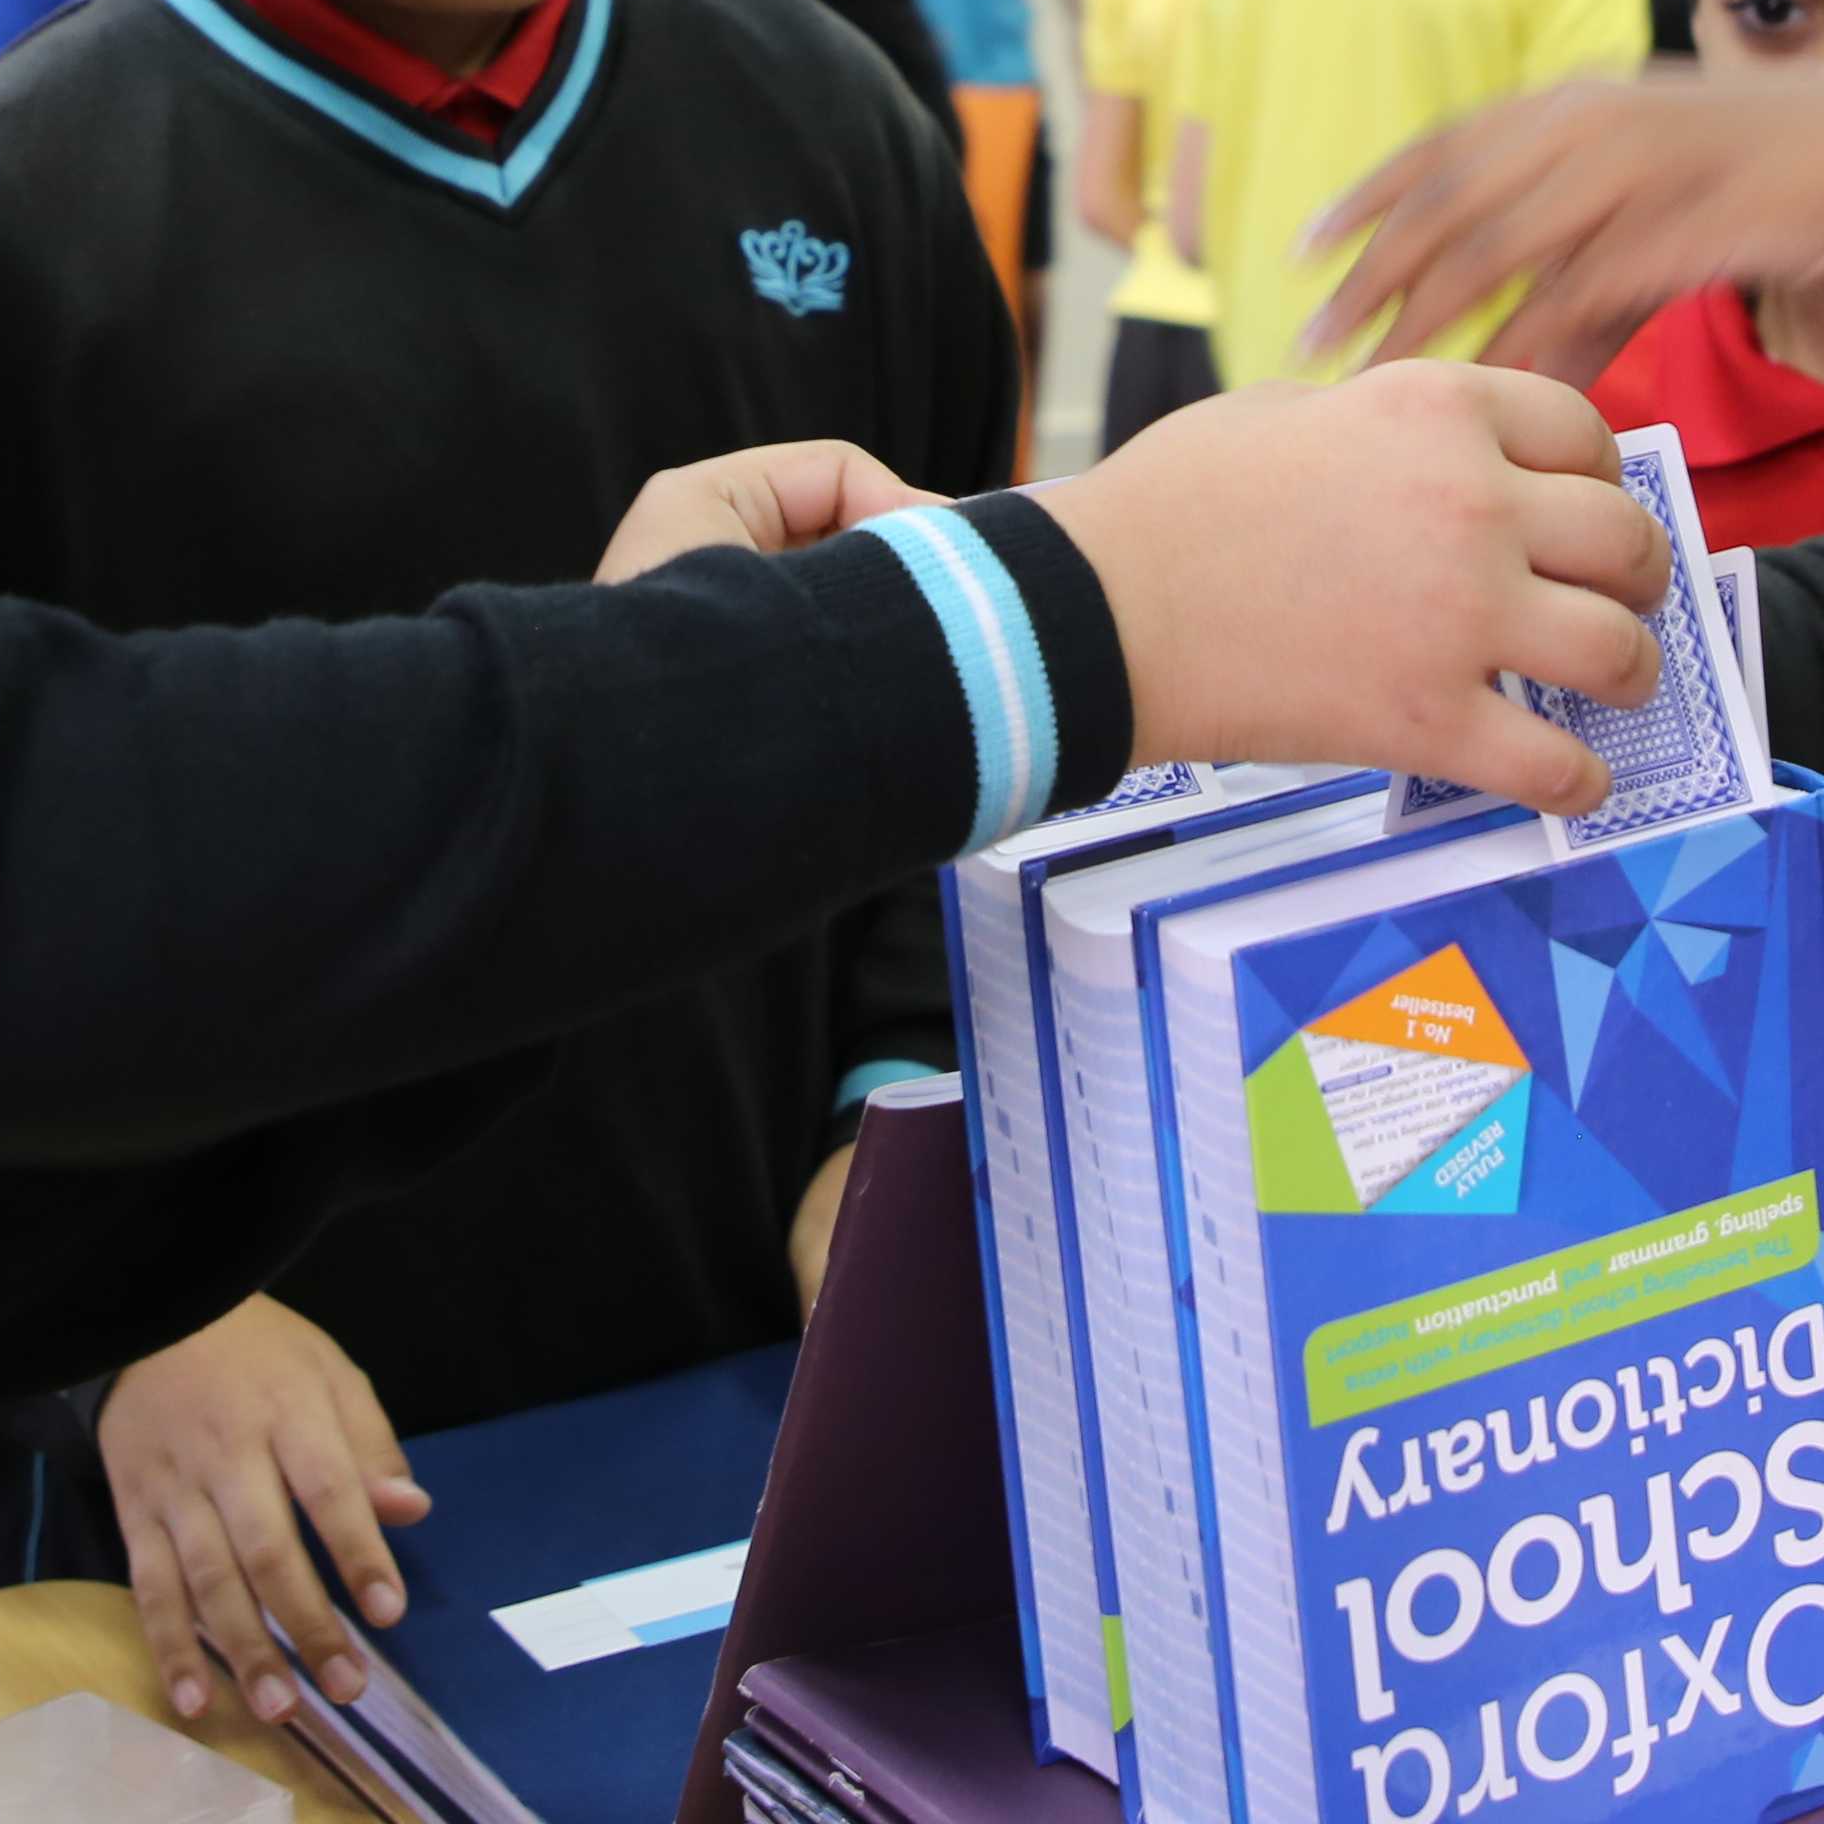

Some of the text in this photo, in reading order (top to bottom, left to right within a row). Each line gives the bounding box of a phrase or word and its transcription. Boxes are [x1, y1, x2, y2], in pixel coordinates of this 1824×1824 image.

[1389, 993, 1475, 1025] bestseller
[1406, 1019, 1452, 1044] No. 1
[1435, 1120, 1505, 1187] REVISED
[1456, 1146, 1505, 1197] FULLY
[1323, 1193, 1805, 1365] spelling, grammar and punctuation support
[1344, 1234, 1792, 1393] The bestselling school dictionary with extra
